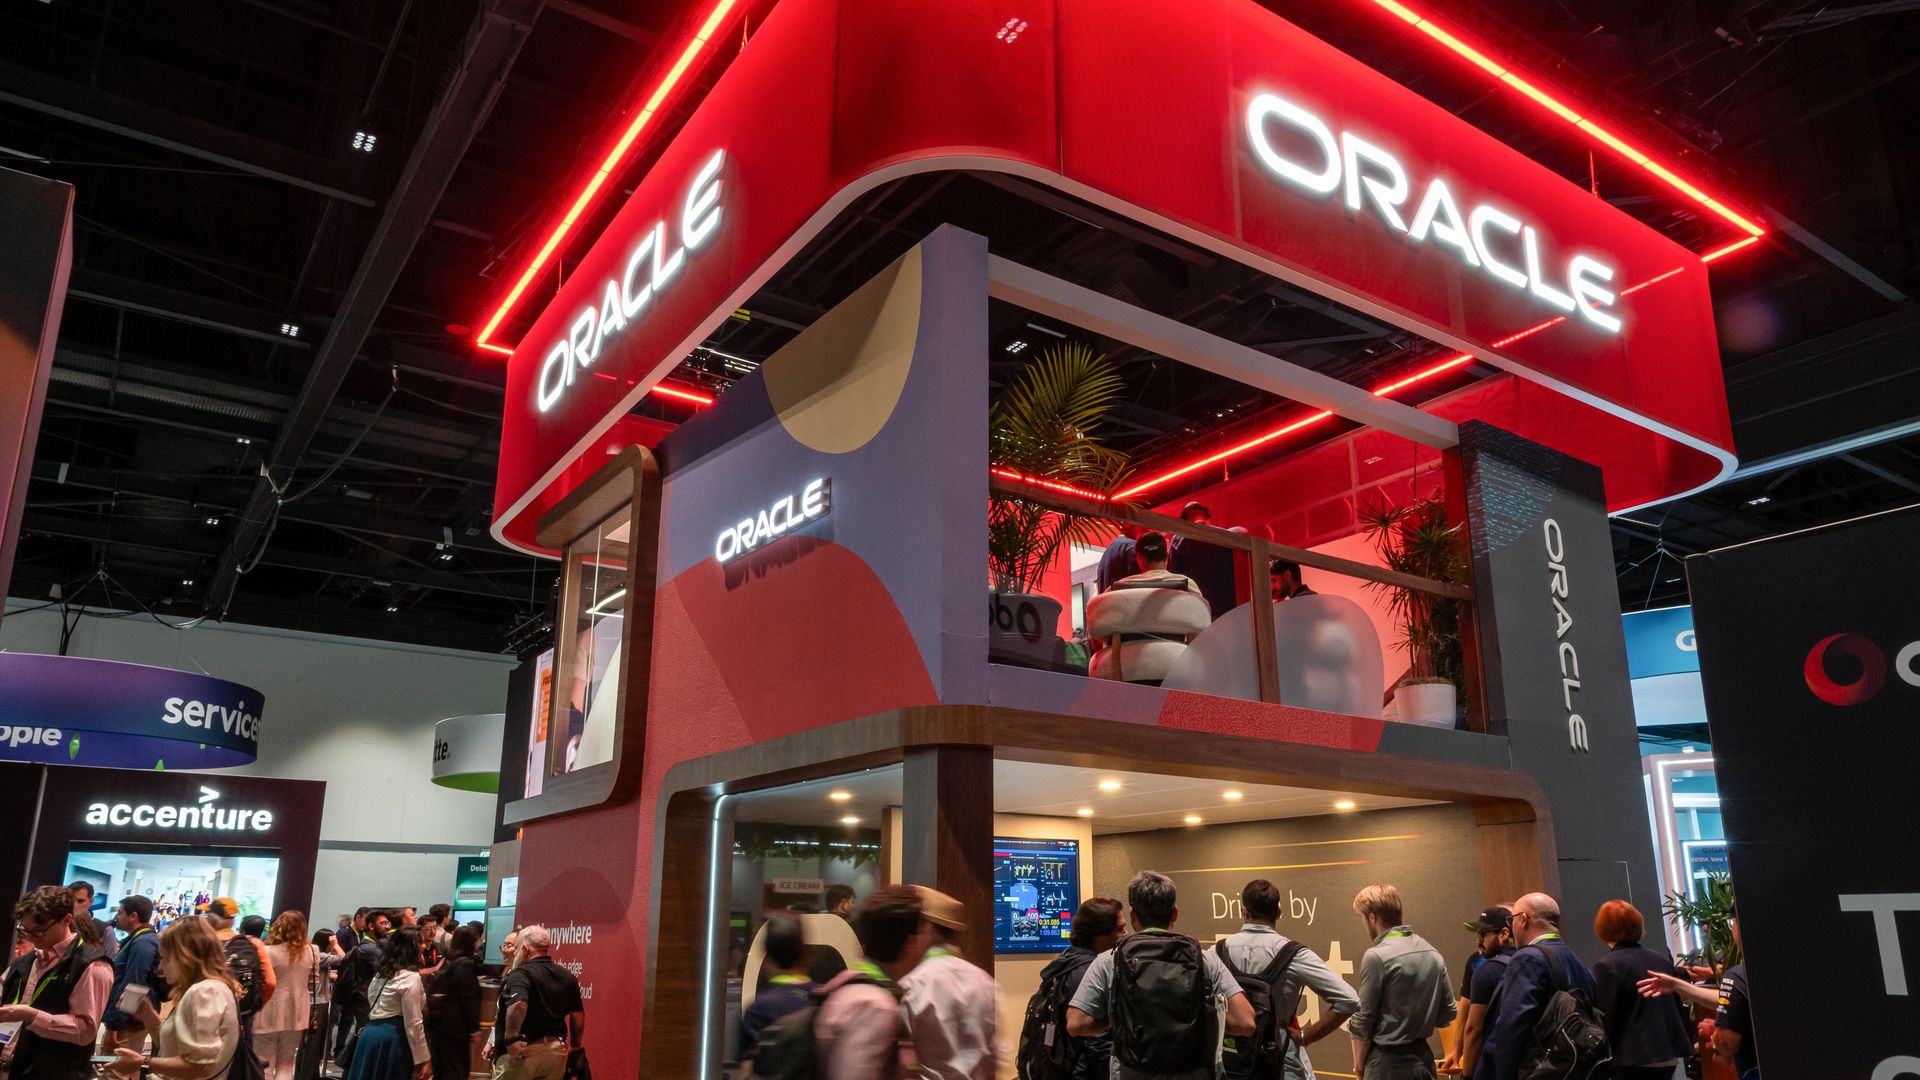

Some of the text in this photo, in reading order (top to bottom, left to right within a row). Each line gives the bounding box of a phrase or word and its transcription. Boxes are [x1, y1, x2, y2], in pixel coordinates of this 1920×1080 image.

[1247, 94, 1622, 333] ORACLE
[538, 149, 728, 412] ORACLE
[715, 477, 828, 562] ORACLE
[1544, 518, 1589, 751] ORACLE
[162, 697, 261, 744] service
[86, 802, 273, 831] accenture
[793, 881, 820, 890] CREAM
[1289, 889, 1317, 926] by
